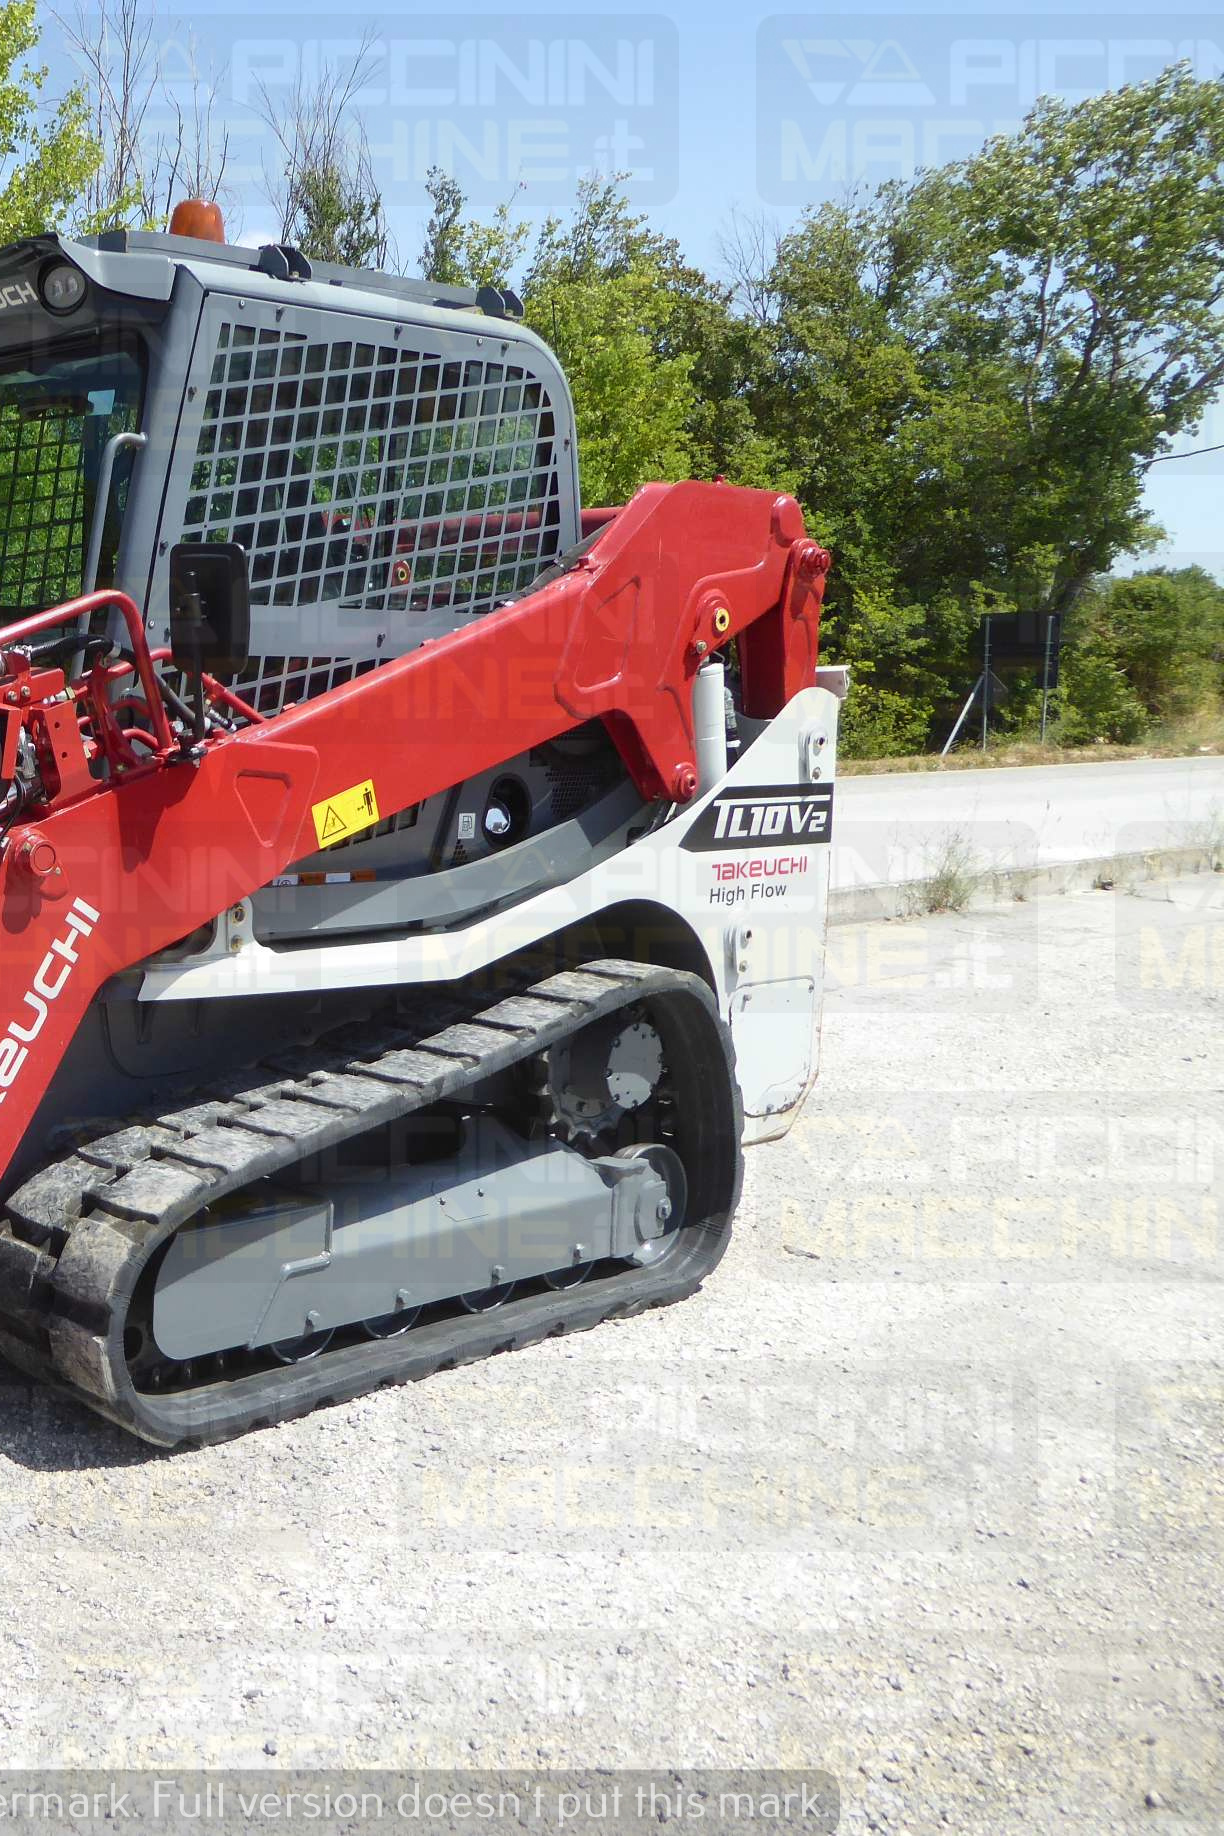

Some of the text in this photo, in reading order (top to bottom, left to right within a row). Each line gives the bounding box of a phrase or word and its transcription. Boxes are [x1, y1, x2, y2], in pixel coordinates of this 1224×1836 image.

[713, 795, 831, 839] TL10V2
[709, 883, 787, 906] High Flow
